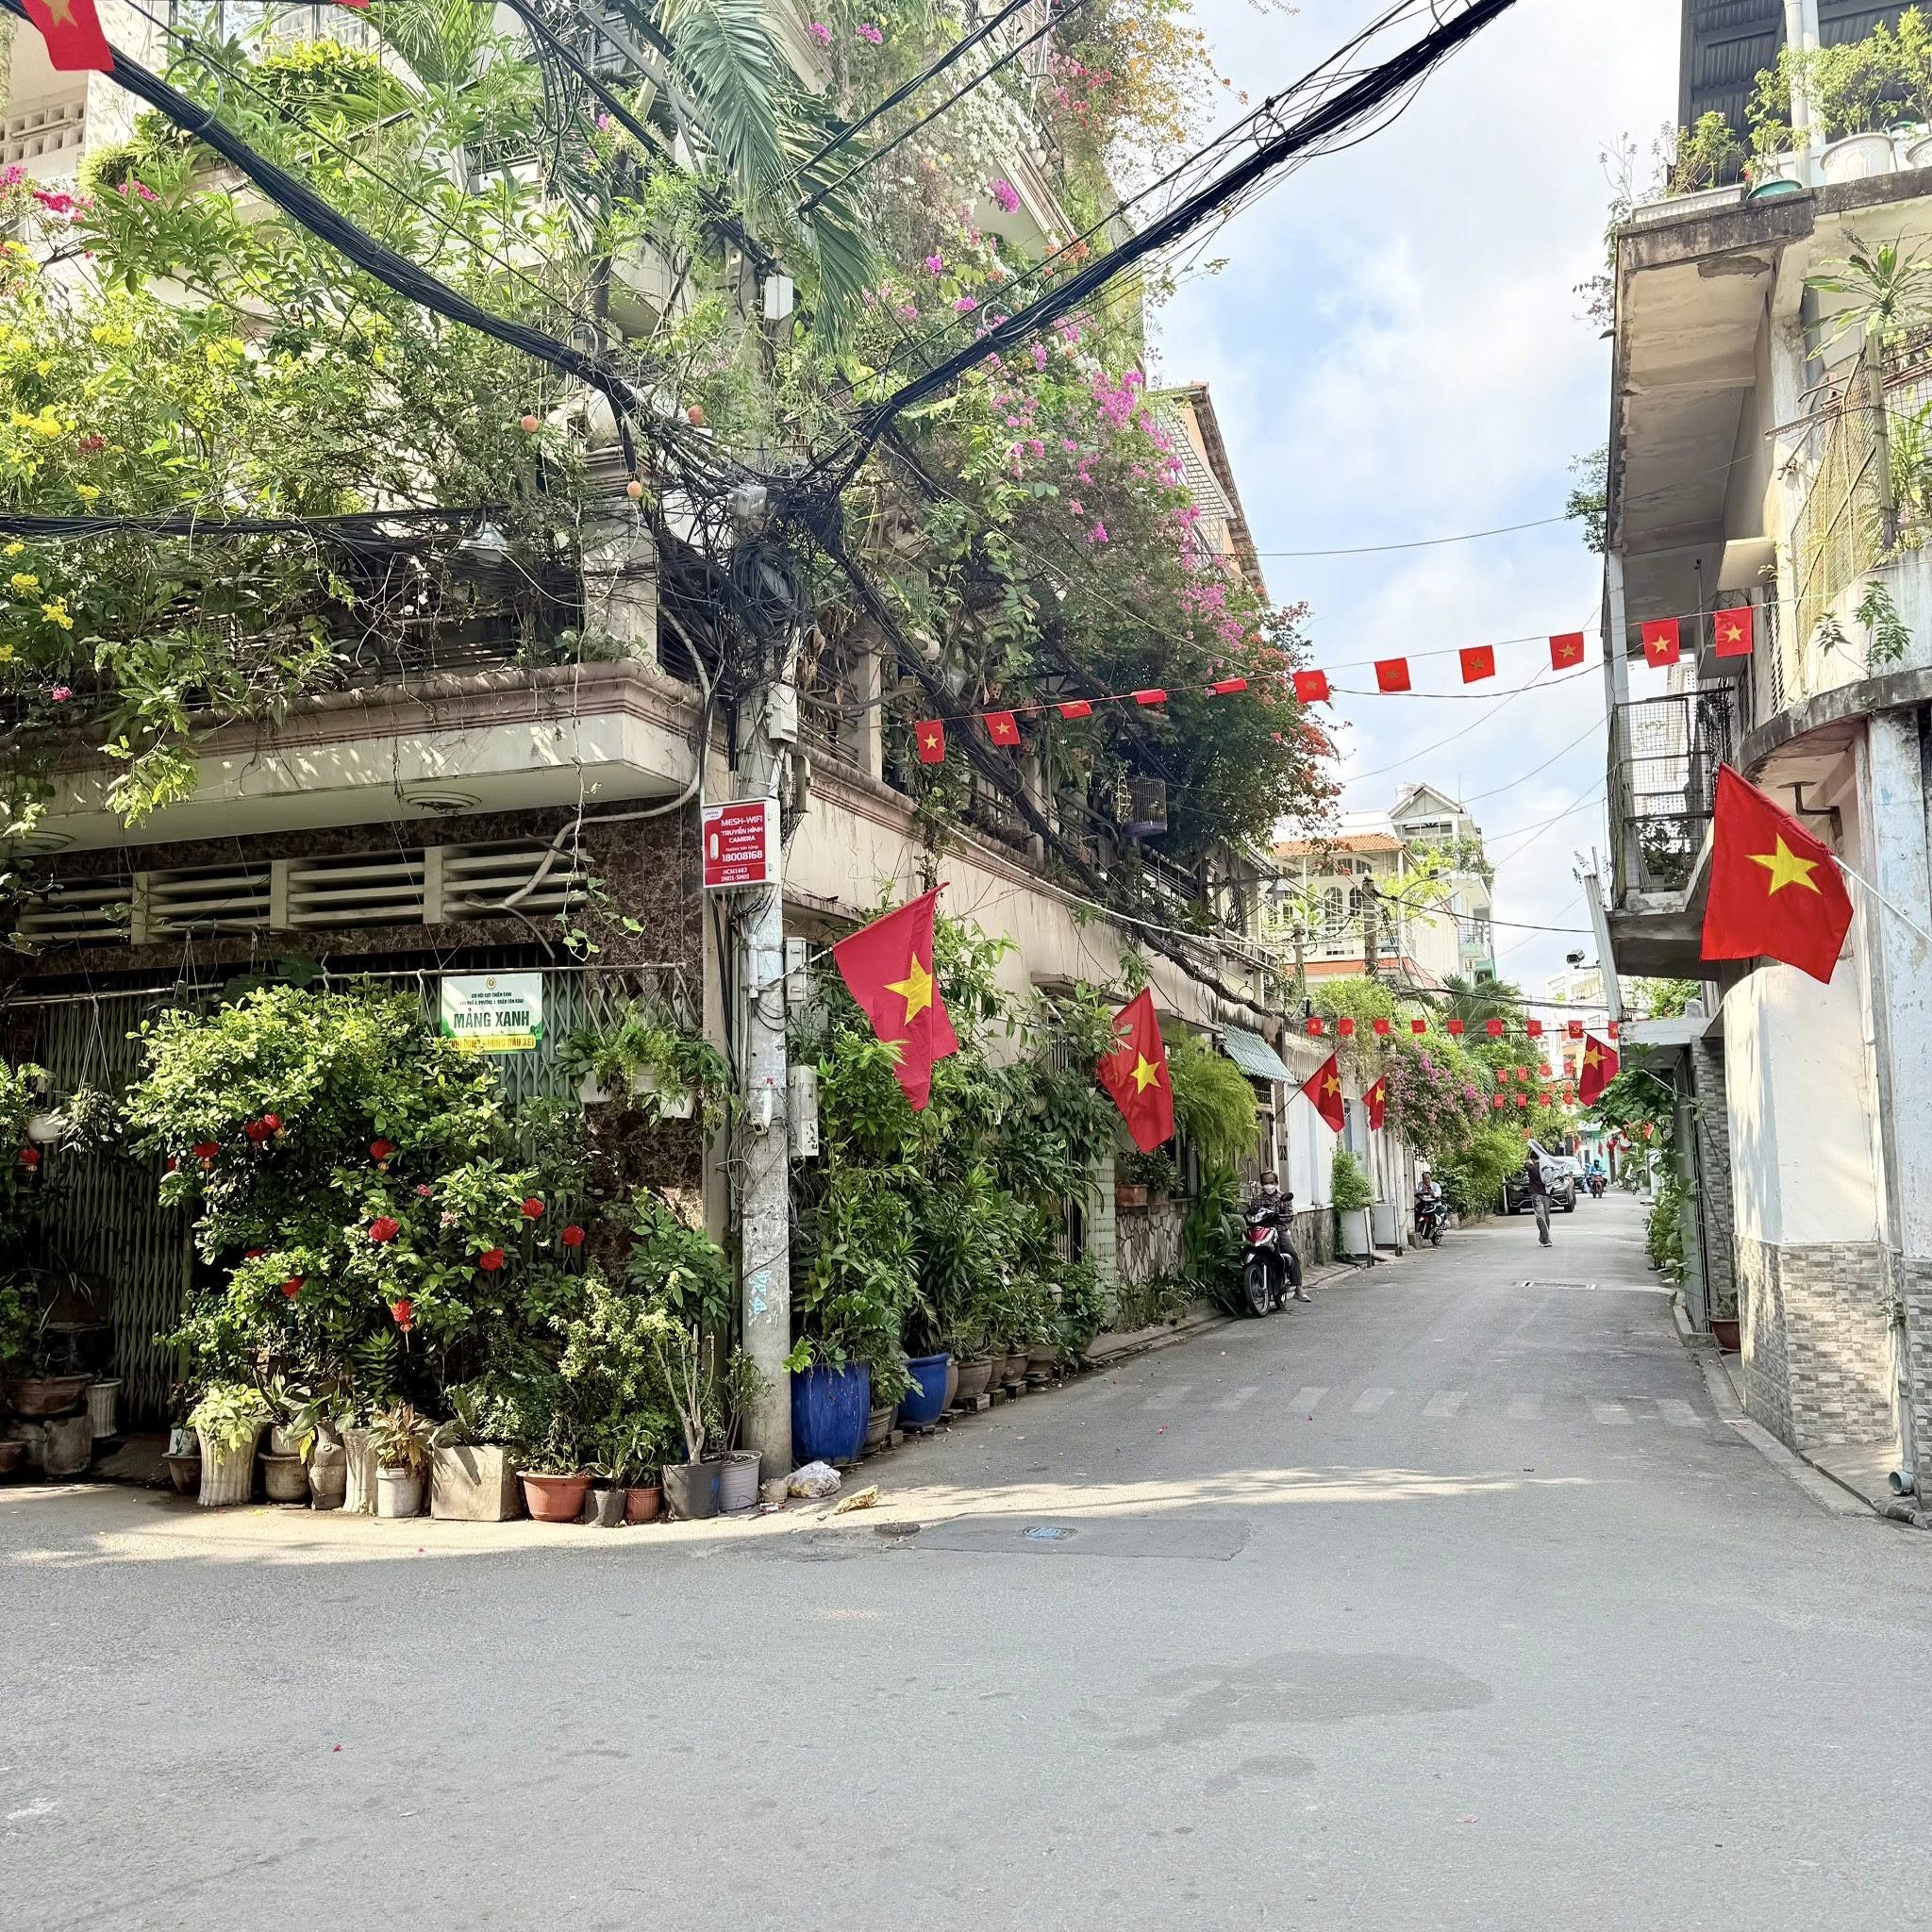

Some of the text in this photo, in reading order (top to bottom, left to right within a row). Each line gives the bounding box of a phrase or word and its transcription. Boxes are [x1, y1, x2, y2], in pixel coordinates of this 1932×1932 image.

[721, 815, 763, 827] MESH-WIFI
[728, 835, 756, 843] CAMERA
[722, 850, 763, 863] 18008168
[453, 1008, 530, 1029] MẢNG XANH
